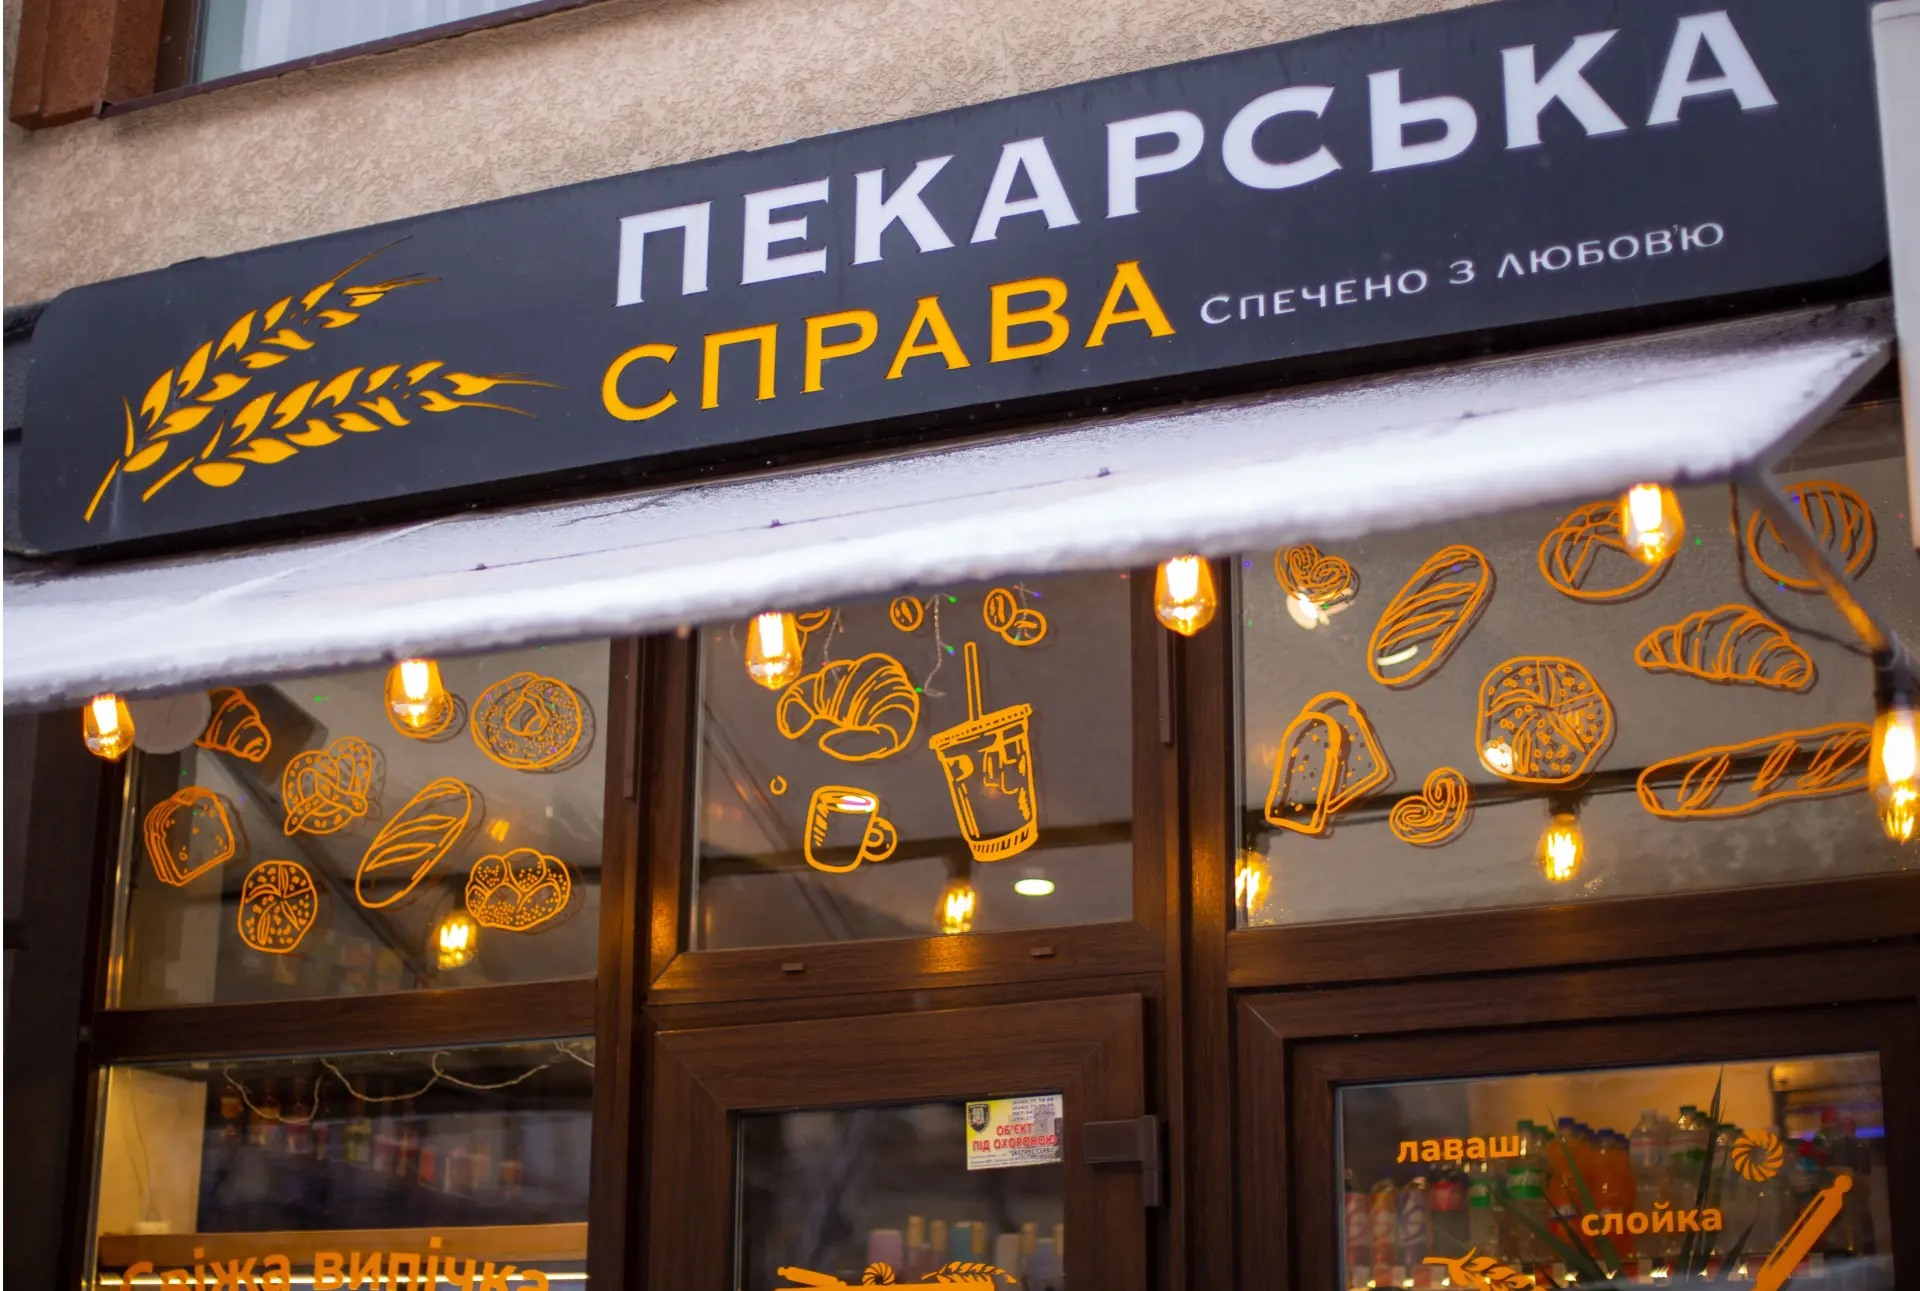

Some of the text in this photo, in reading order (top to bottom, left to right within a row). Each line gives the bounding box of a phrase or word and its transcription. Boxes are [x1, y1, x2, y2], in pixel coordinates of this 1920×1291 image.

[614, 9, 1778, 308] ПЕКАРСЬКА
[1200, 222, 1725, 325] СПЕЧЕНО З ЛЮБОВ'Ю
[601, 259, 1176, 422] СПРАВА
[972, 1134, 1058, 1152] ПІД ОХОРОНОЮ
[996, 1123, 1033, 1136] ОБ'ЄКТ
[1396, 1134, 1520, 1163] лаваш
[1581, 1201, 1723, 1236] слойка
